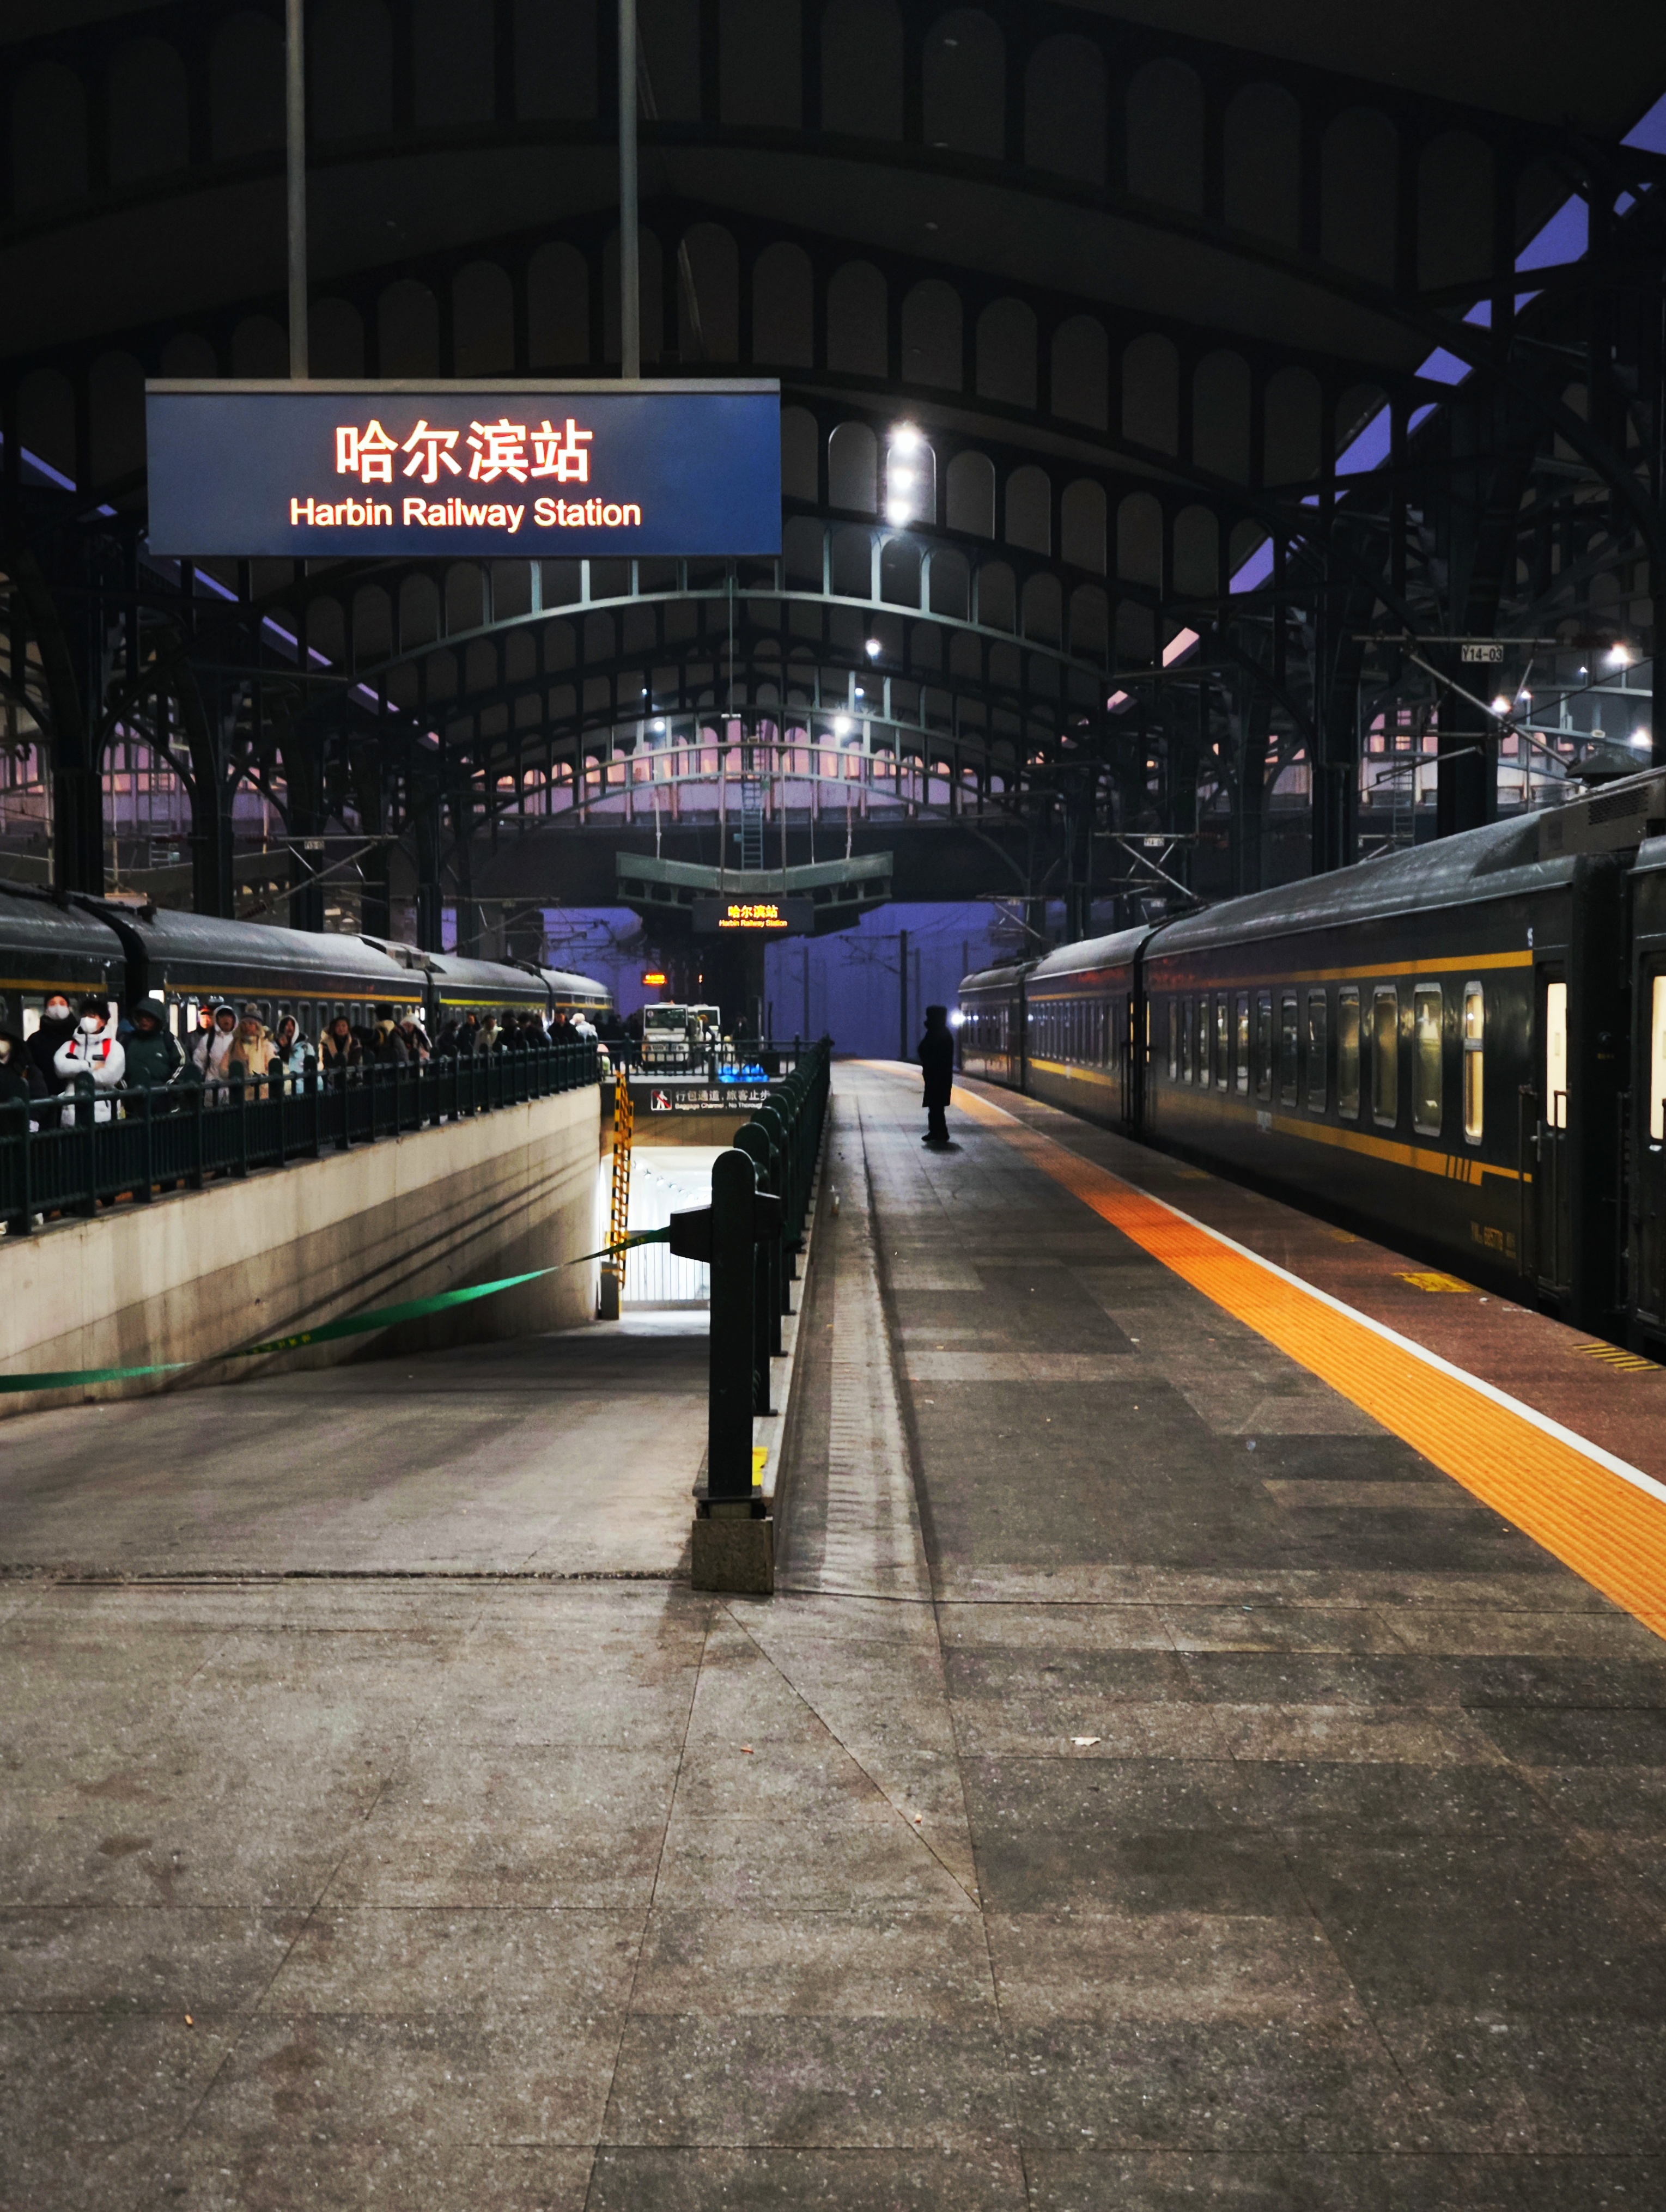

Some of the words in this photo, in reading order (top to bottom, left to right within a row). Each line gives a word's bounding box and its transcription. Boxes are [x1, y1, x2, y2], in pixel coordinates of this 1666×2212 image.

[335, 417, 593, 484] 哈尔滨站
[290, 497, 393, 527] Harbin
[403, 497, 525, 534] Railway
[533, 497, 641, 527] Station
[728, 905, 779, 918] 哈尔滨站
[740, 919, 765, 928] Railway
